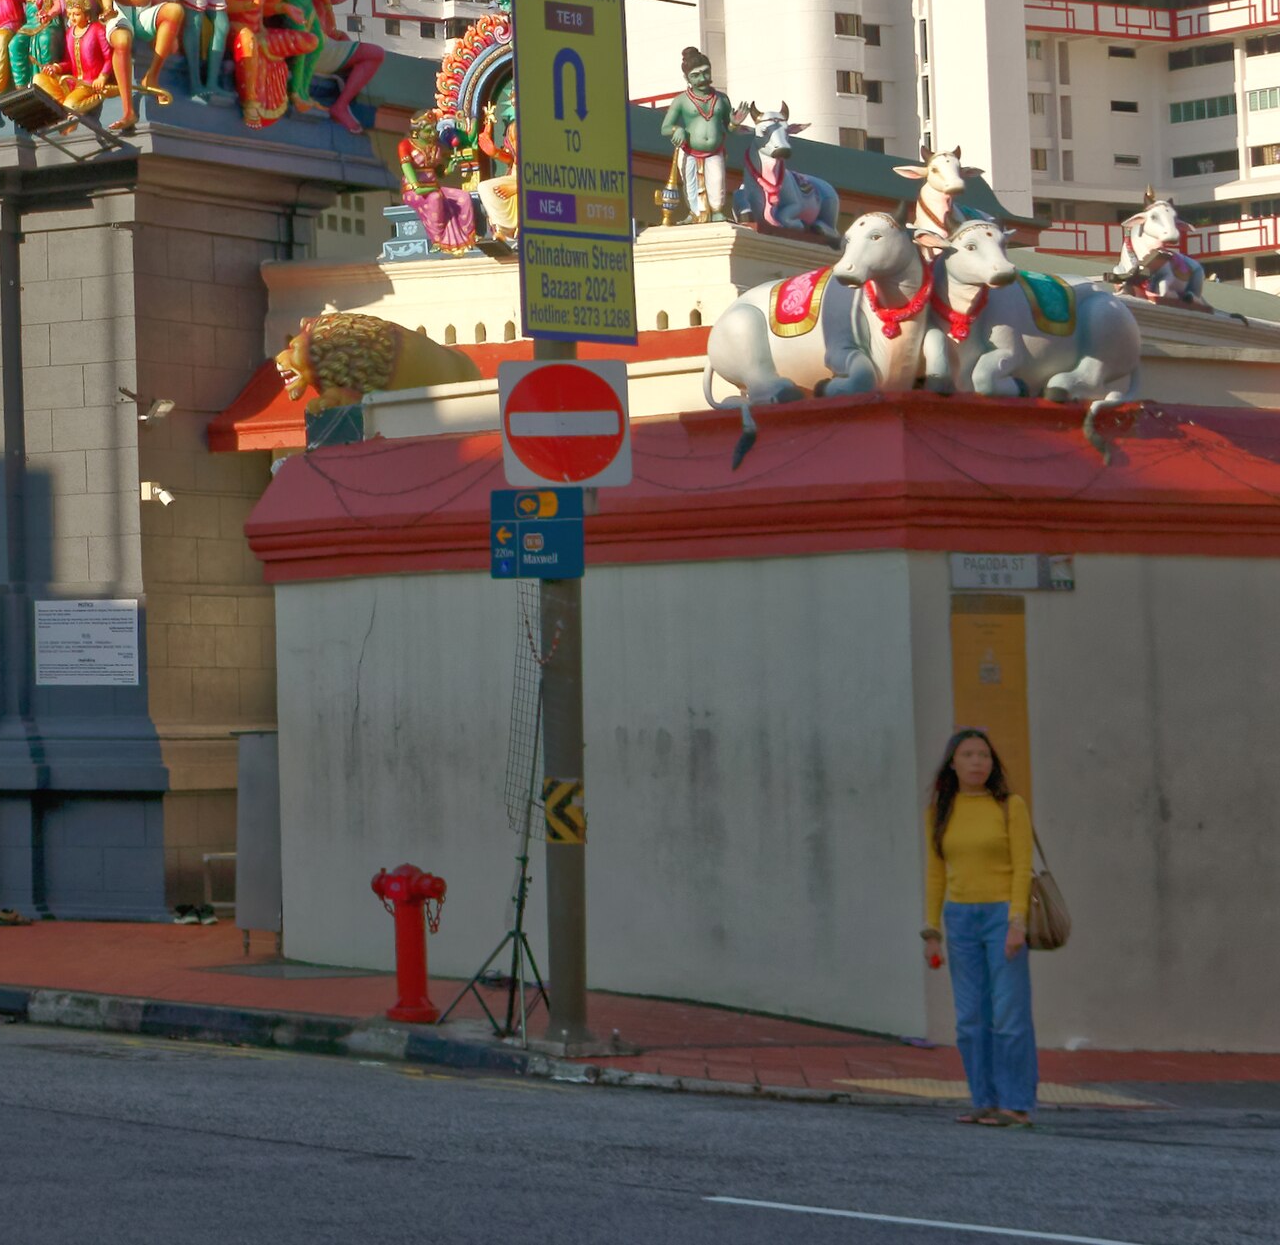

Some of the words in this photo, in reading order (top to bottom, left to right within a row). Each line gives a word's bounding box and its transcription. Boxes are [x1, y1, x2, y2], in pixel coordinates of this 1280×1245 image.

[556, 10, 583, 26] TE18
[565, 129, 581, 152] TO
[523, 162, 597, 191] CHINATOWN
[600, 169, 625, 193] MRT
[539, 199, 563, 215] NE4
[526, 239, 589, 268] Chinatown
[592, 245, 628, 272] Street
[541, 272, 582, 300] Bazaar
[585, 276, 616, 303] 2024
[530, 303, 570, 325] Hotline:
[573, 306, 600, 326] 9273
[603, 309, 630, 328] 1268
[495, 548, 514, 558] 220m
[523, 552, 558, 564] Maxwell
[963, 557, 1009, 571] PAGODA
[1011, 557, 1025, 571] ST
